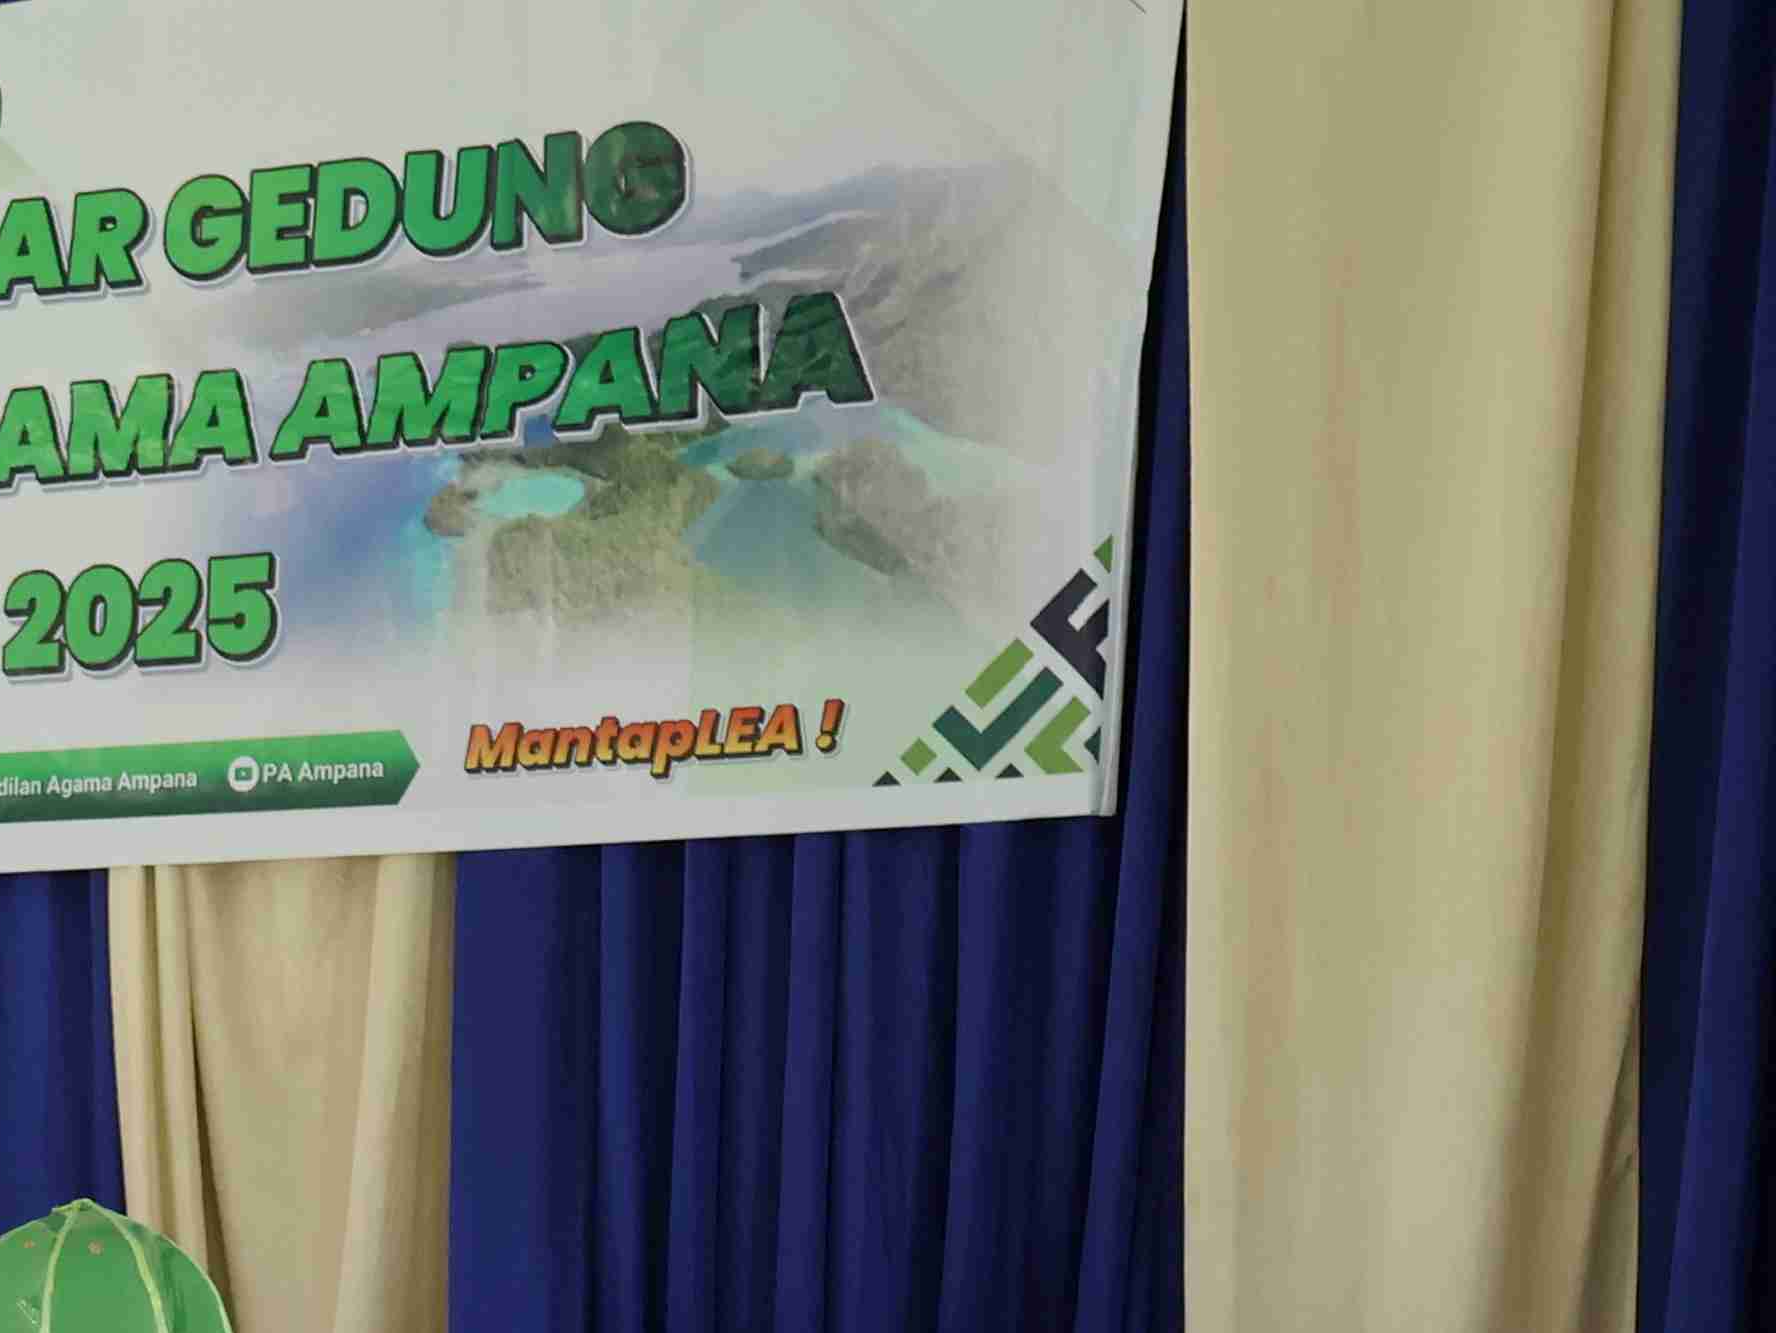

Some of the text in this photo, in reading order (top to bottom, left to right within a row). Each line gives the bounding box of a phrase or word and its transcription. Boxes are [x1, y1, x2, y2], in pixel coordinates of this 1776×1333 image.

[164, 121, 687, 280] GEDUNG
[270, 292, 875, 462] AMPANA
[2, 552, 277, 676] 2025
[47, 774, 113, 799] Agama
[117, 769, 198, 797] Ampana
[263, 758, 385, 785] PA Ampana
[464, 704, 803, 778] MantapLEA
